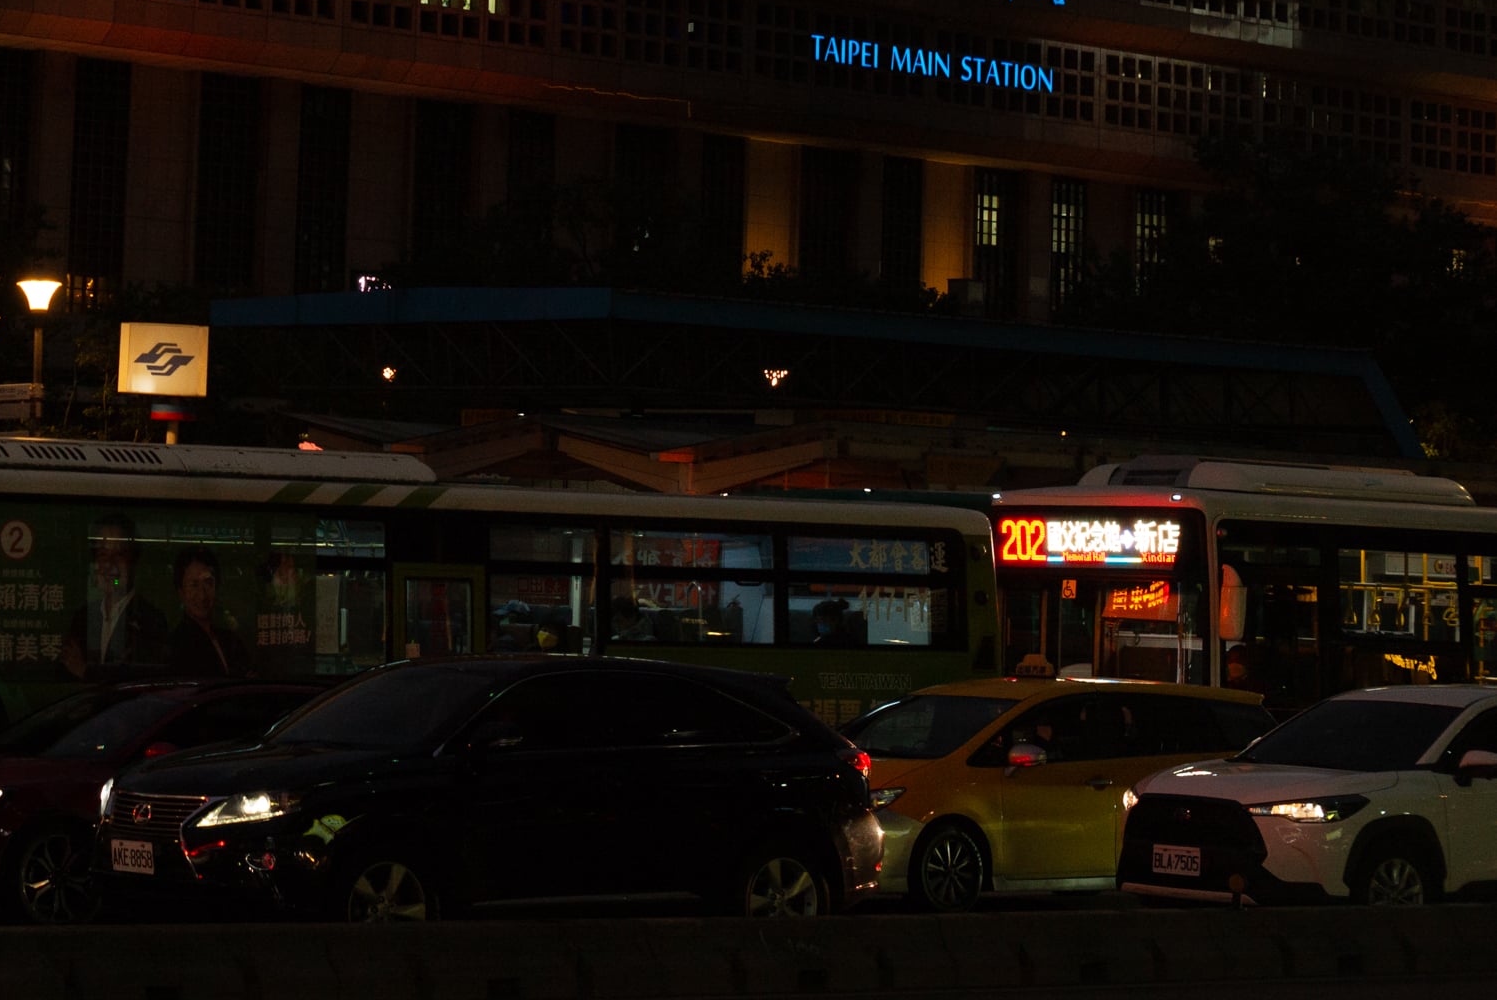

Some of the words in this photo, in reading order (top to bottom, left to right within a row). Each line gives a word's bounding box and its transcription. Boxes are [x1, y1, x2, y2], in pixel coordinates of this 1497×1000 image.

[811, 34, 879, 69] TAIPEI
[890, 46, 951, 79] MAIN
[960, 56, 1054, 93] STATION
[1002, 520, 1046, 560] 202
[1135, 520, 1180, 552] 新店
[1092, 552, 1105, 562] Hall
[818, 672, 856, 689] TEAM
[857, 673, 913, 690] TAIWAN
[1154, 852, 1199, 872] BLA-7505
